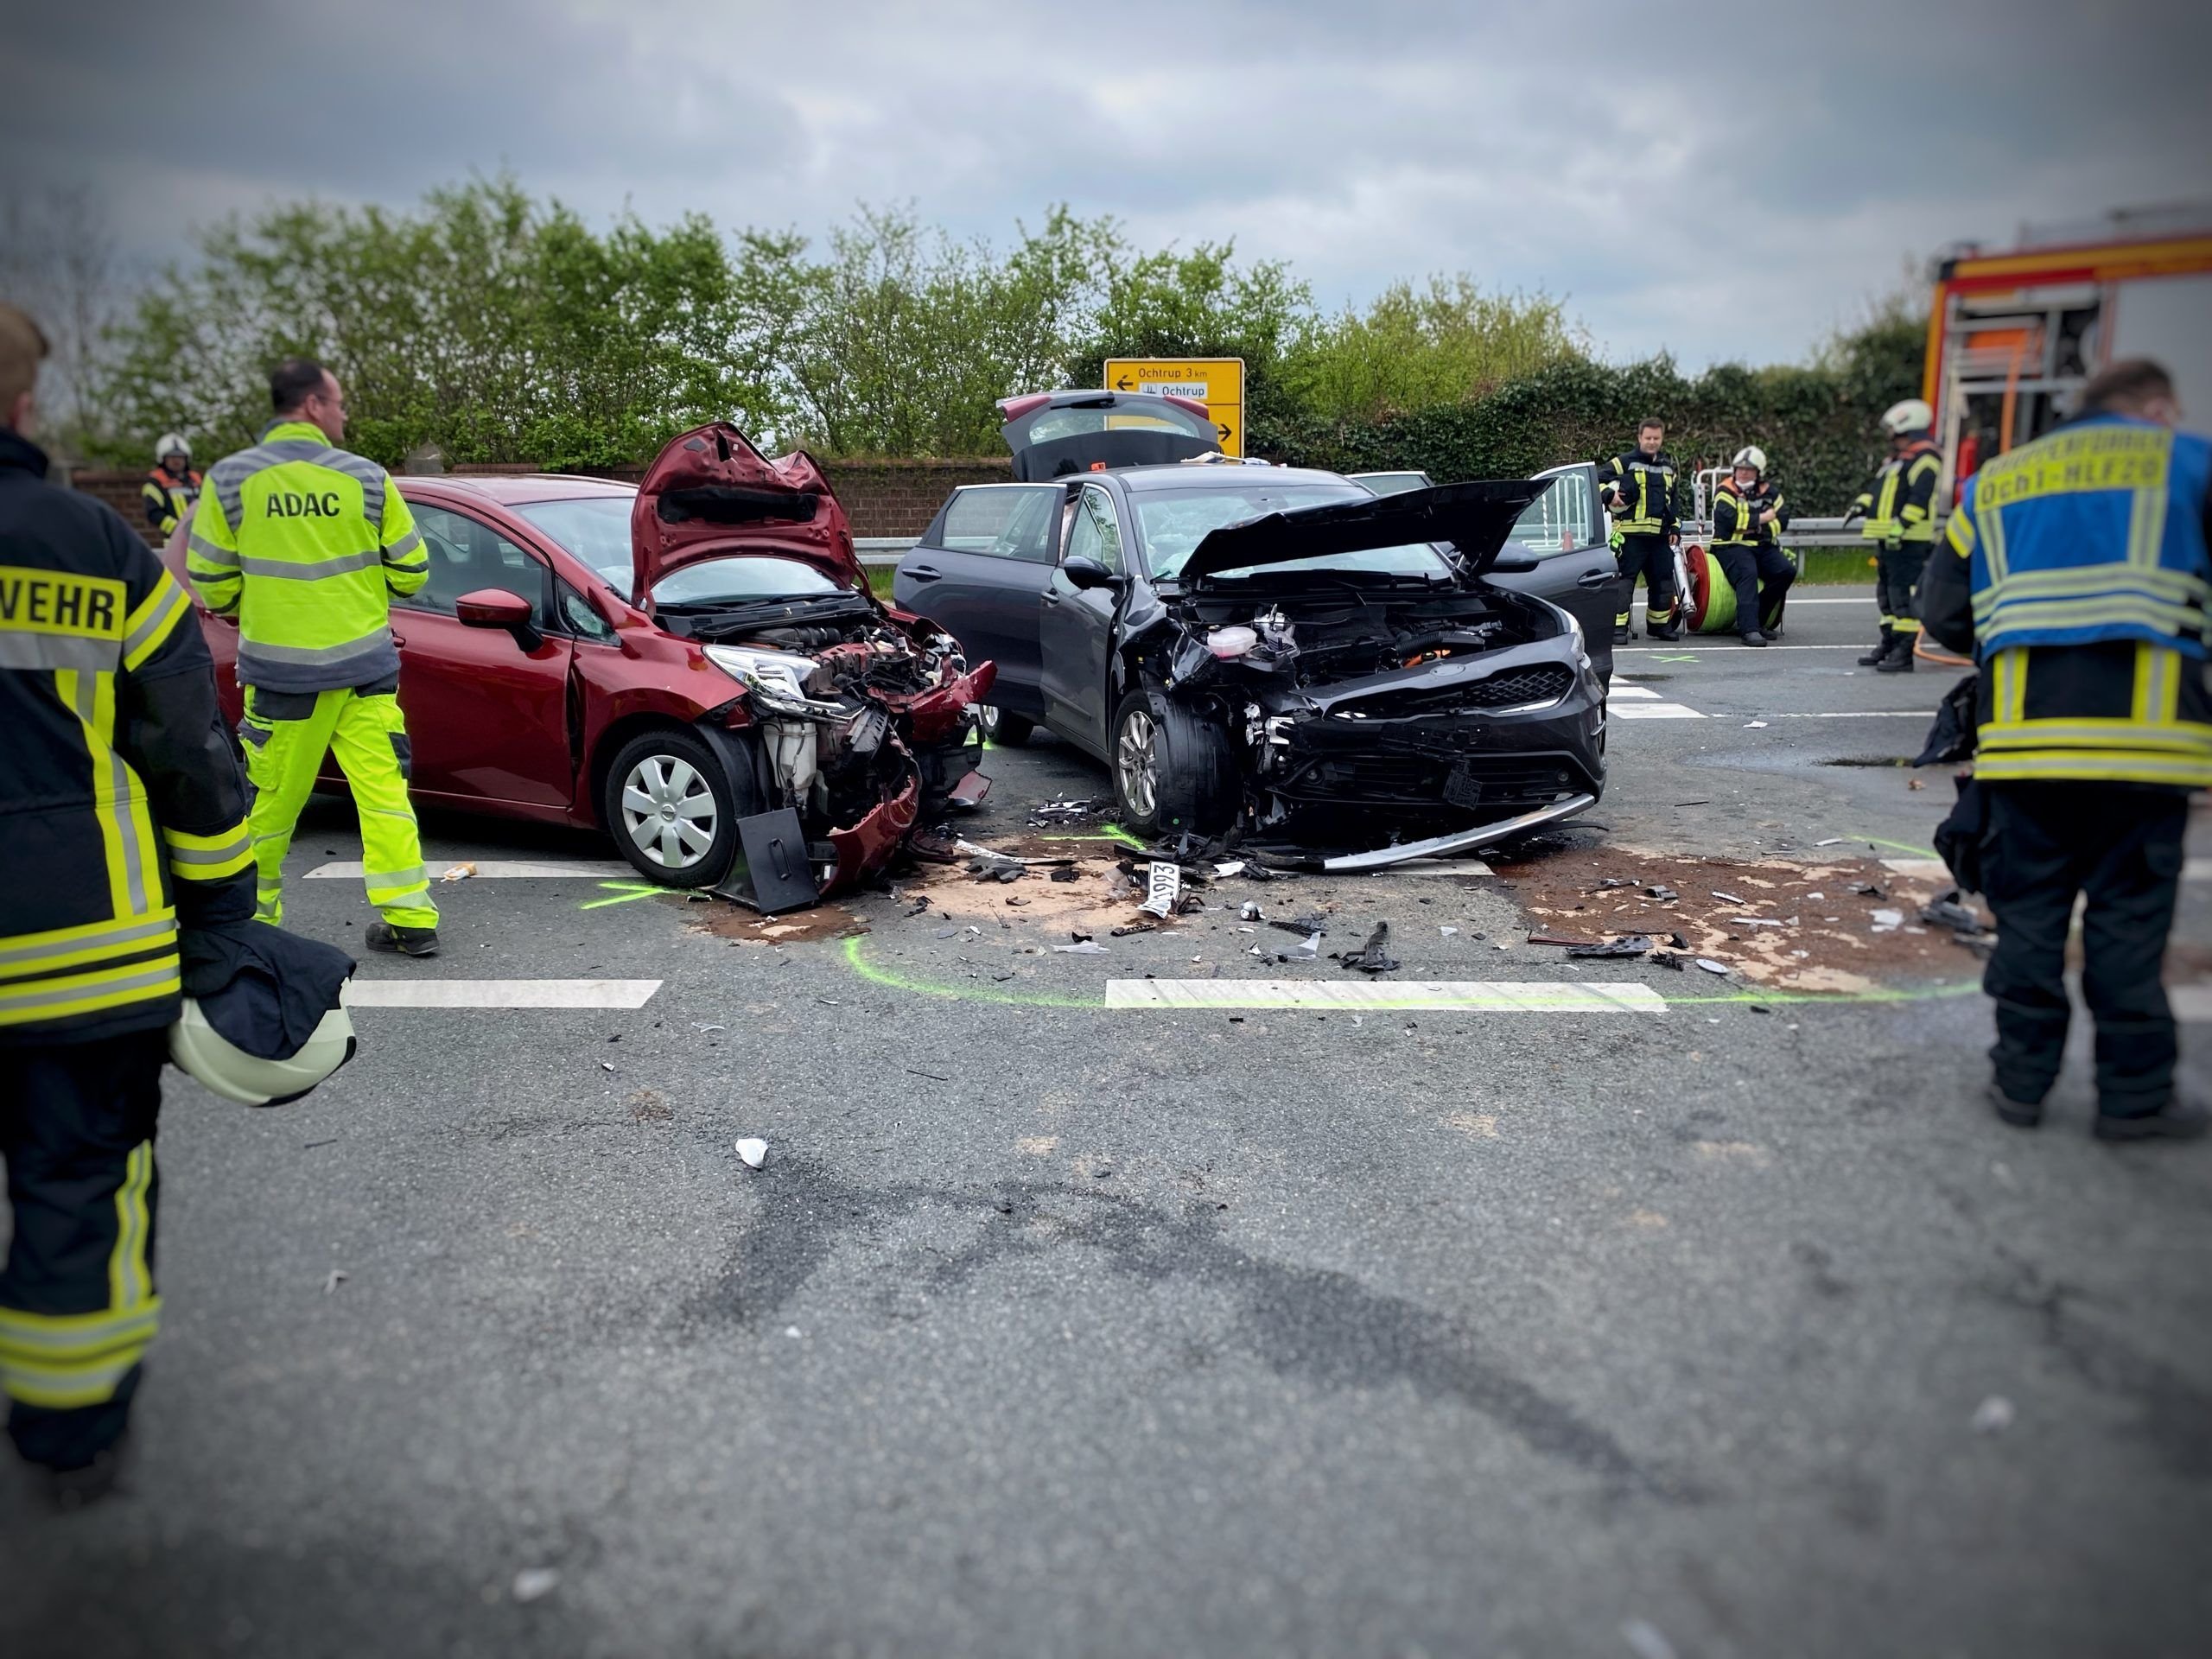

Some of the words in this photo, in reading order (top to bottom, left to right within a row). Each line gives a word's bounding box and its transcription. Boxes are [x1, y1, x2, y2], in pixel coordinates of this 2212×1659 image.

[1139, 368, 1181, 378] Ochtrup
[1185, 368, 1192, 378] 3
[1195, 369, 1208, 378] km
[1162, 386, 1205, 397] Ochtrup
[266, 493, 340, 518] ADAC
